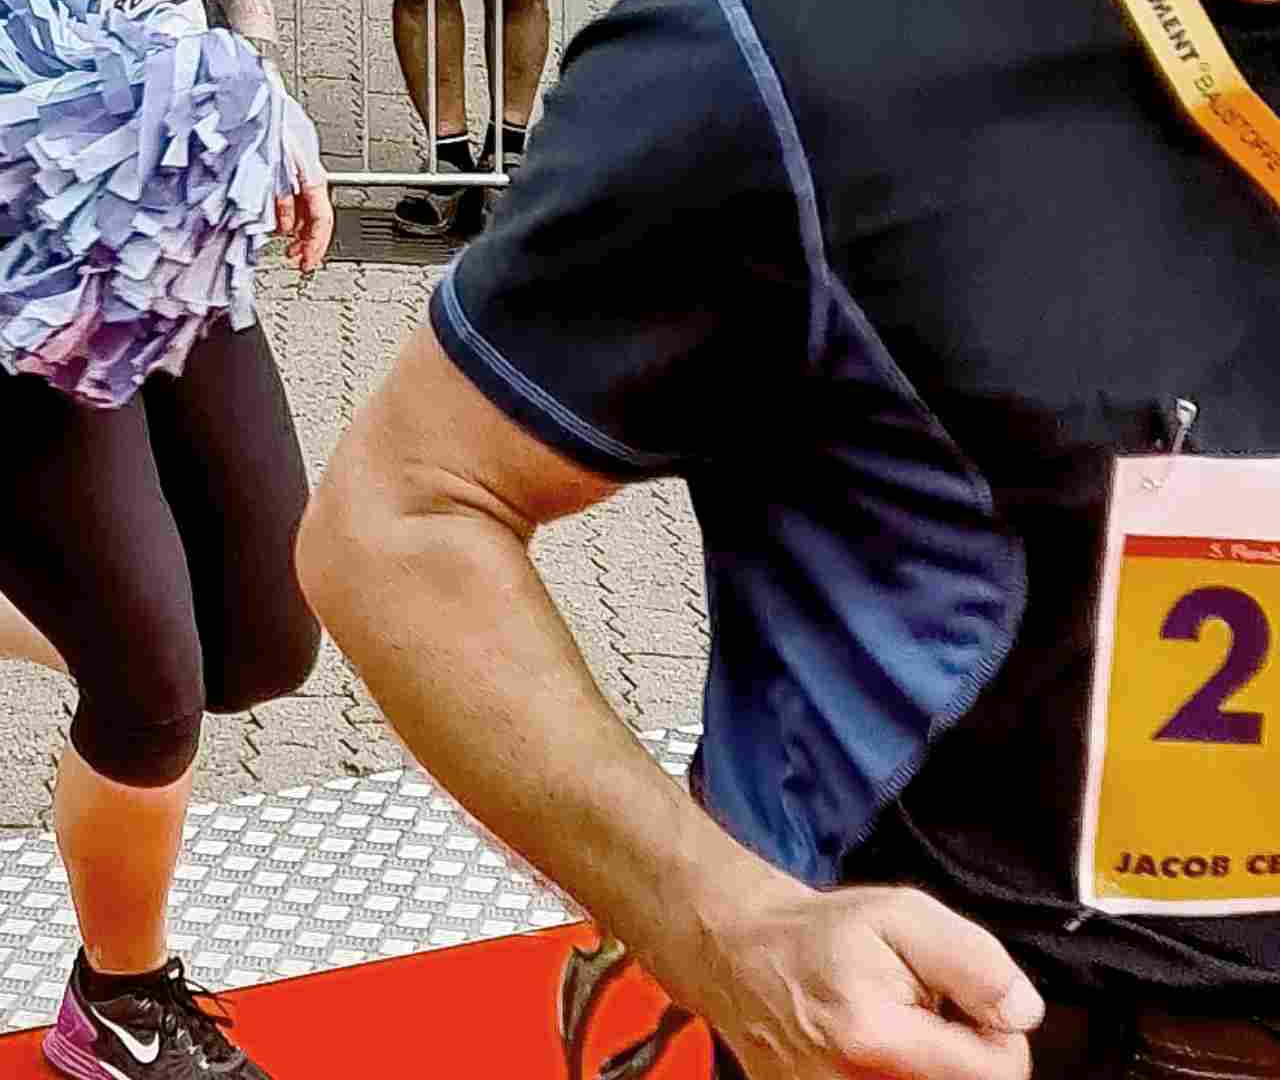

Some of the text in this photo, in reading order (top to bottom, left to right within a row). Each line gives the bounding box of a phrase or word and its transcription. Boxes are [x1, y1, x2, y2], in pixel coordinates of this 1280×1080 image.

[1152, 584, 1271, 746] 2
[1113, 852, 1280, 878] JACOB CE
